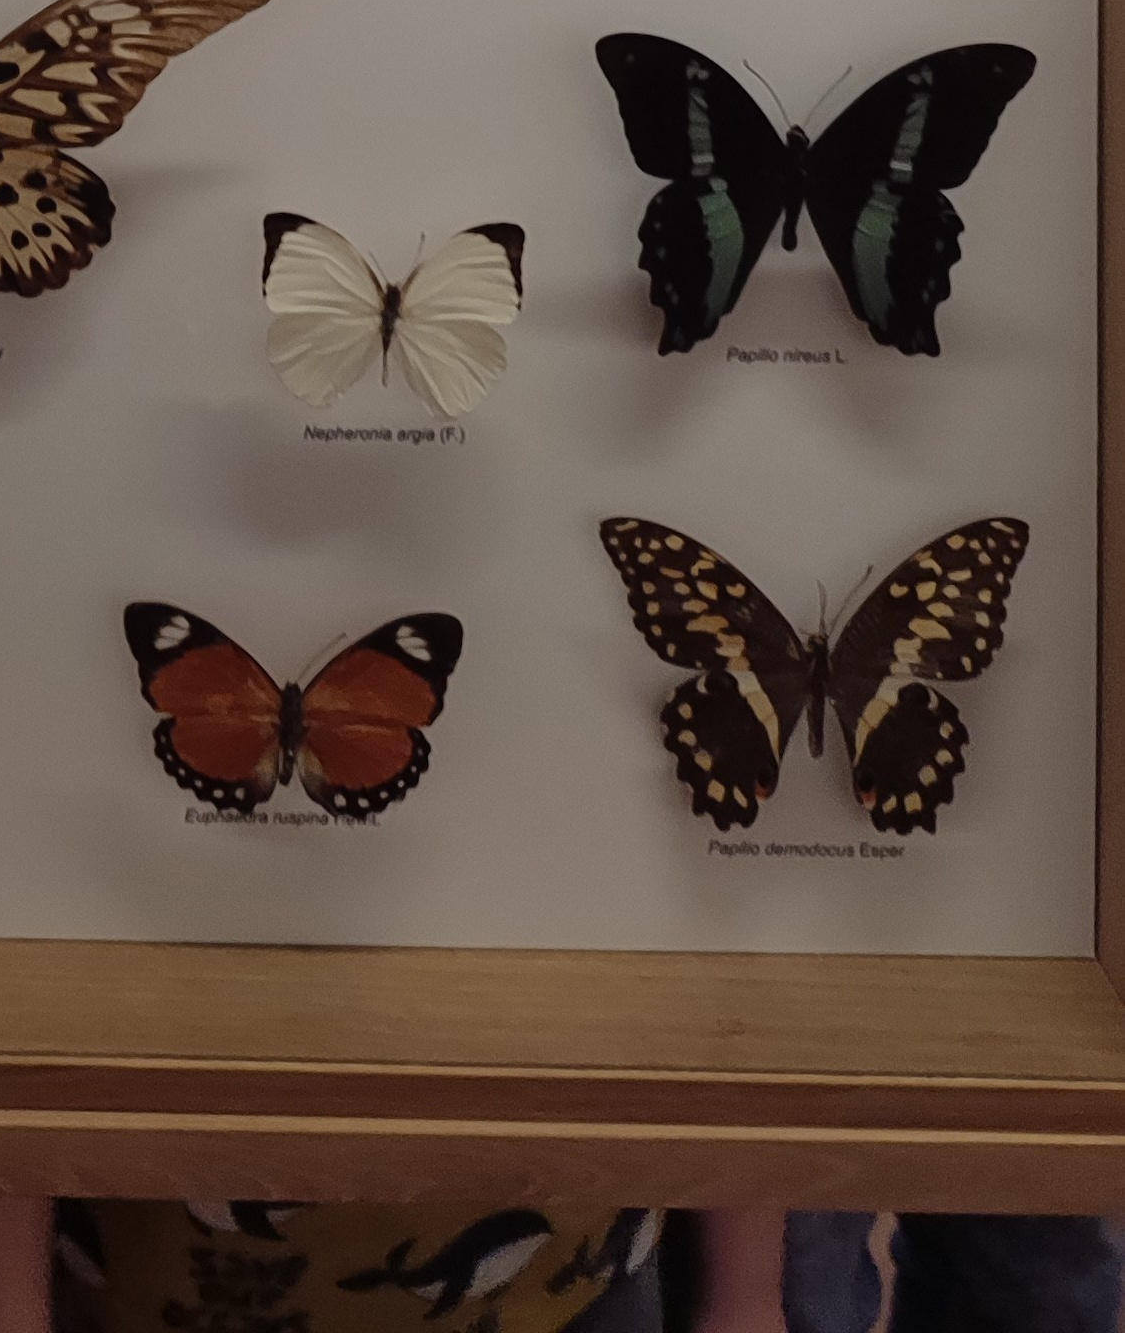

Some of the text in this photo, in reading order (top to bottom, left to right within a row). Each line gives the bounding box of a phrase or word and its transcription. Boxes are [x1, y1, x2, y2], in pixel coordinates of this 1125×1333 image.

[727, 347, 779, 364] Papilio
[304, 425, 392, 442] Nepheronia
[708, 839, 759, 857] Papilio
[765, 842, 854, 857] demodocus
